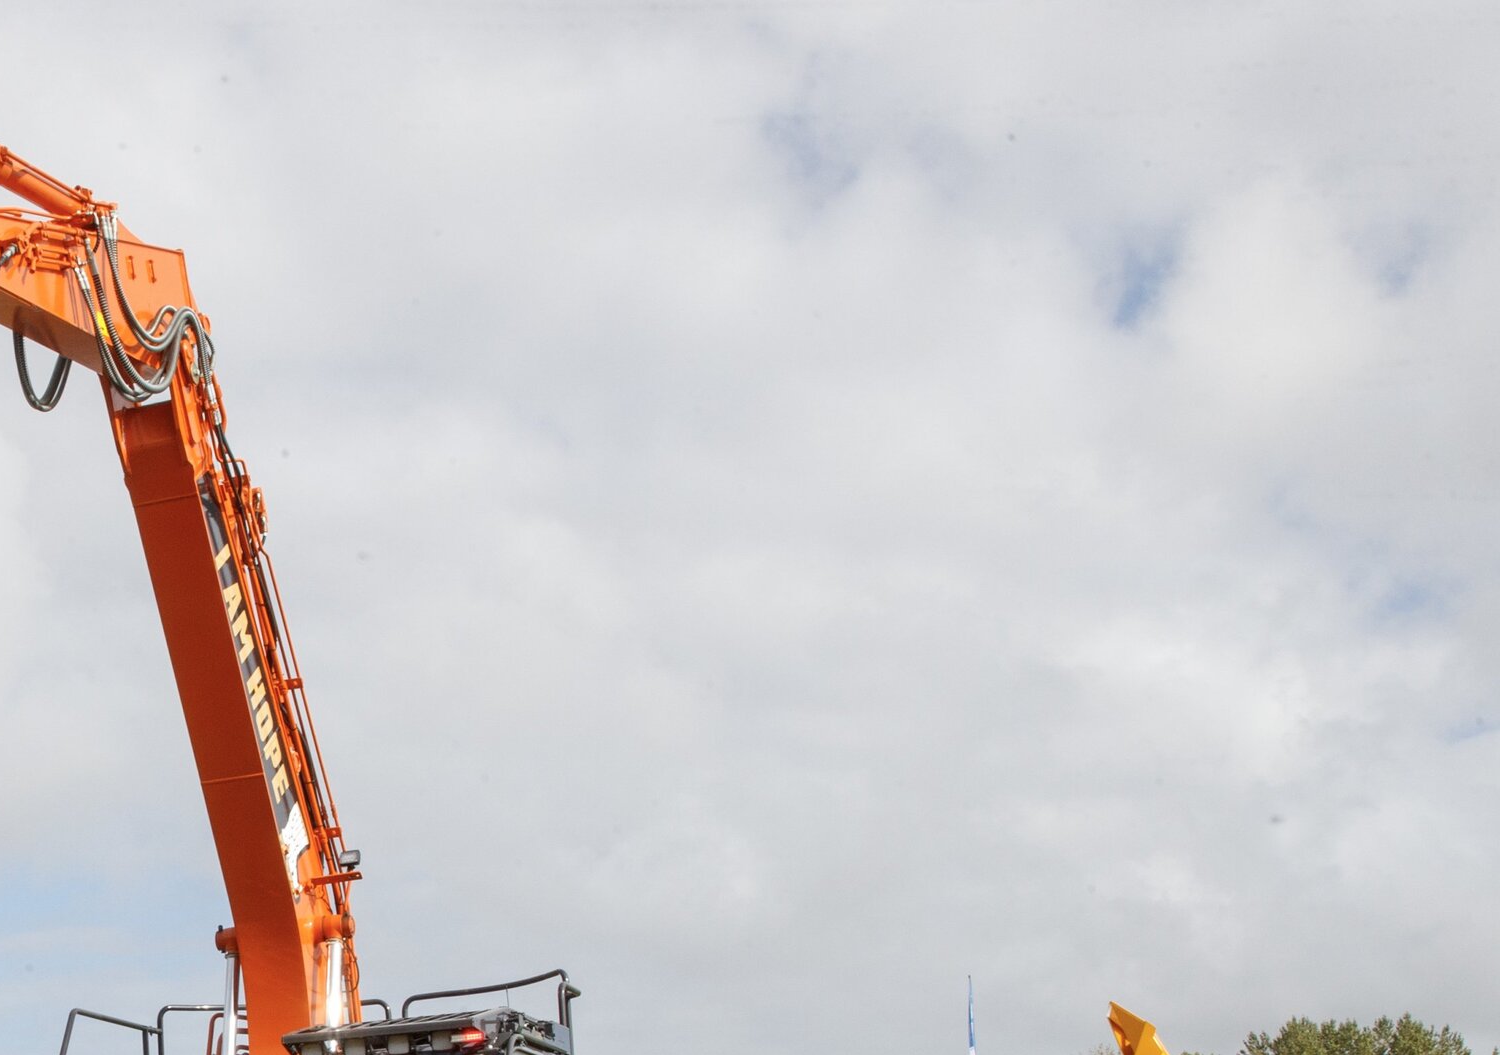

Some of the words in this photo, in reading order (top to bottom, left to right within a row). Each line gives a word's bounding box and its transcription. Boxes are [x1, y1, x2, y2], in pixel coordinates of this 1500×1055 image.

[214, 543, 231, 571] I
[223, 581, 253, 664] AM
[246, 665, 289, 804] HOPE
